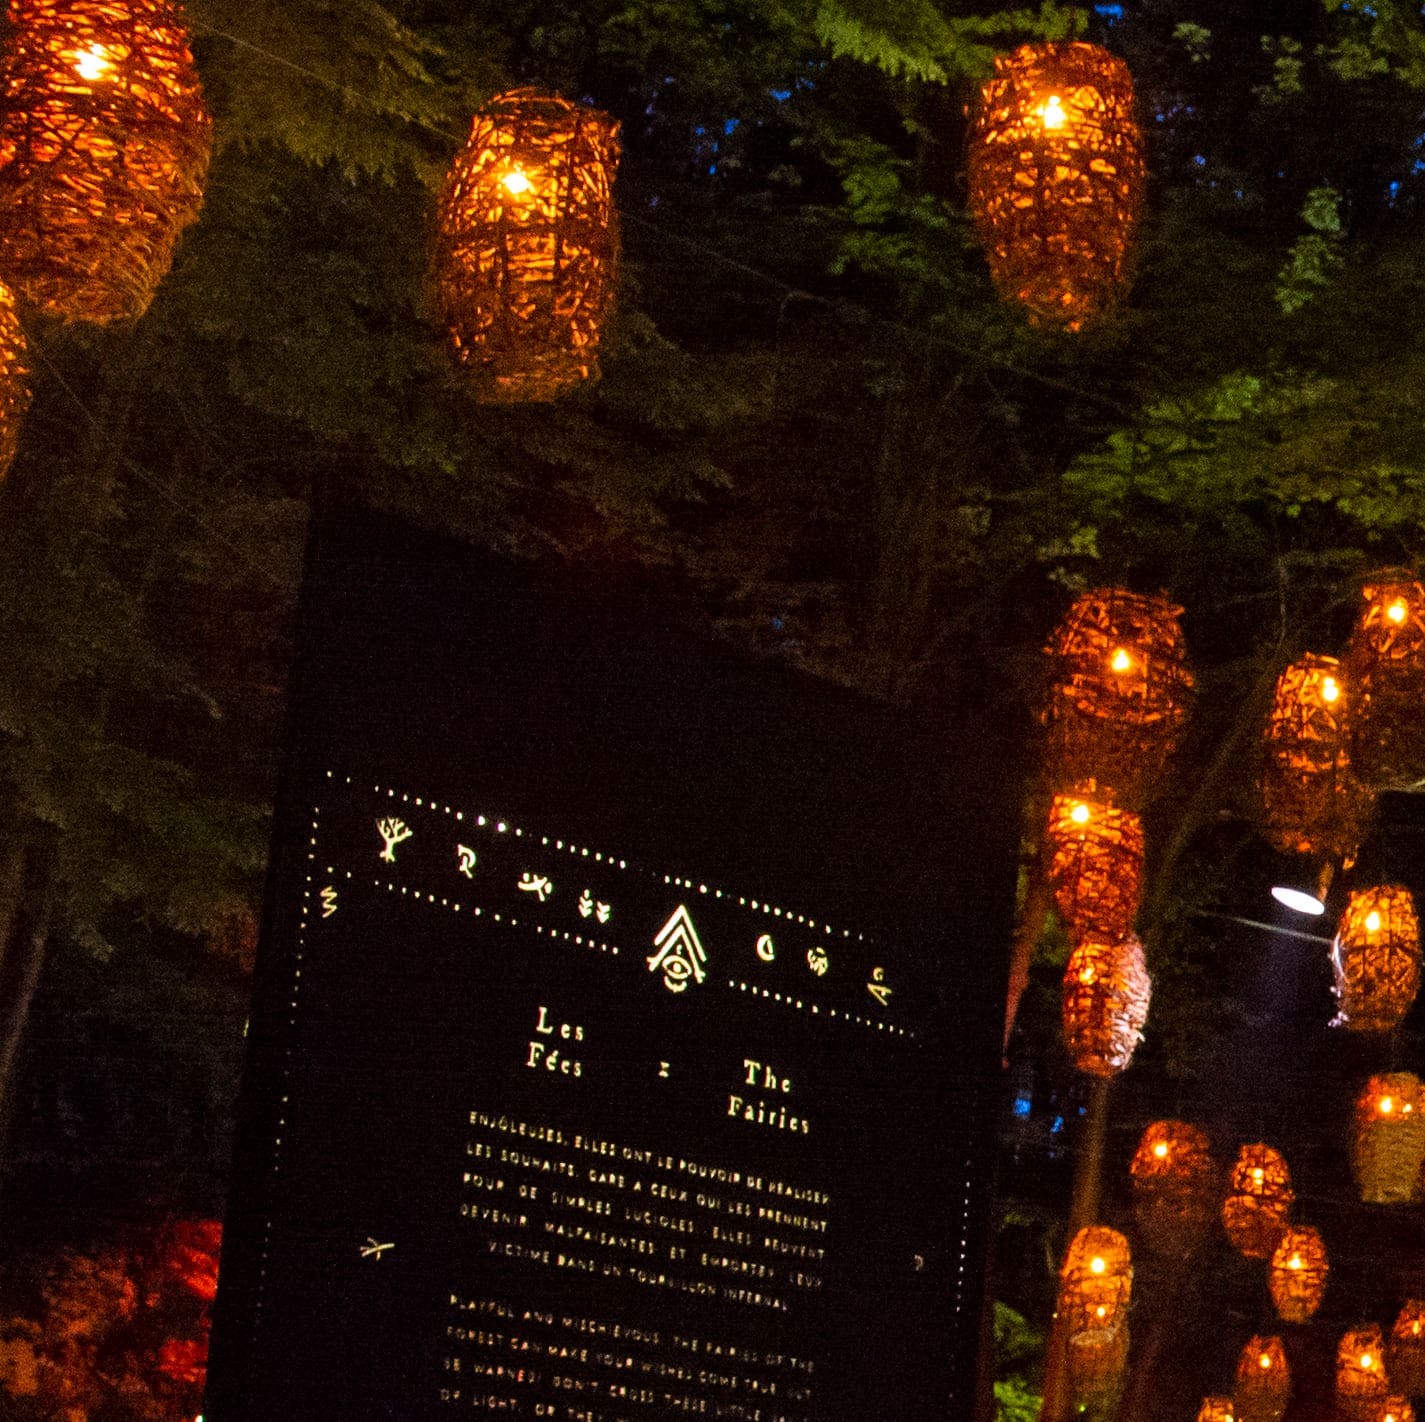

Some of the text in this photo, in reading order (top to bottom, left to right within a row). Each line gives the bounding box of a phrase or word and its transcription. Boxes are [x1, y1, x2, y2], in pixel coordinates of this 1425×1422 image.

[532, 1007, 583, 1043] Les
[527, 1038, 583, 1076] Fées
[744, 1059, 790, 1092] The
[728, 1091, 808, 1133] Fairies
